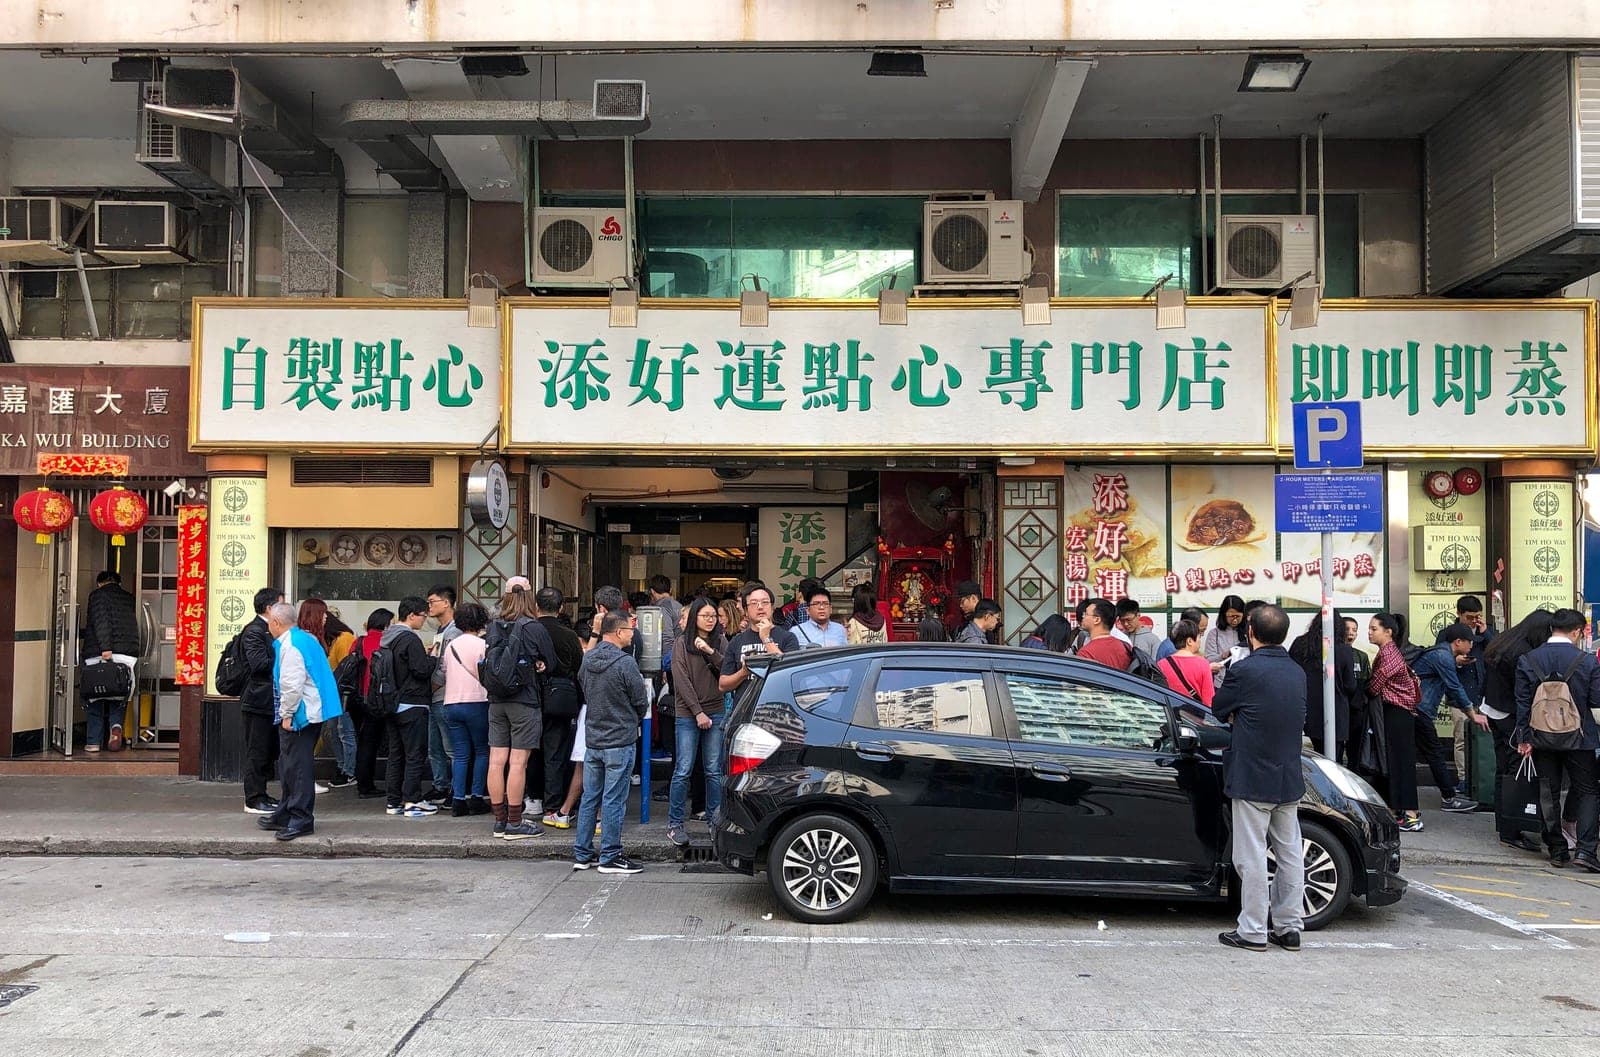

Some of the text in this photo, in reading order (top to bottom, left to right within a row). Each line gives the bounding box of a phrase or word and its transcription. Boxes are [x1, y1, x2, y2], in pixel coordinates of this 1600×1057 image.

[0, 384, 170, 415] 嘉匯大廈
[220, 336, 484, 412] 自製點心
[538, 337, 1231, 412] 添好運點心專門店
[1290, 340, 1568, 416] 即叫即蒸
[1, 433, 170, 449] KA WUI BUILDING
[57, 457, 110, 471] 出入平安
[1306, 409, 1348, 462] P
[777, 511, 827, 606] 添好
[1092, 472, 1129, 605] 添好運
[1421, 602, 1435, 610] TIM
[1437, 602, 1450, 610] HO
